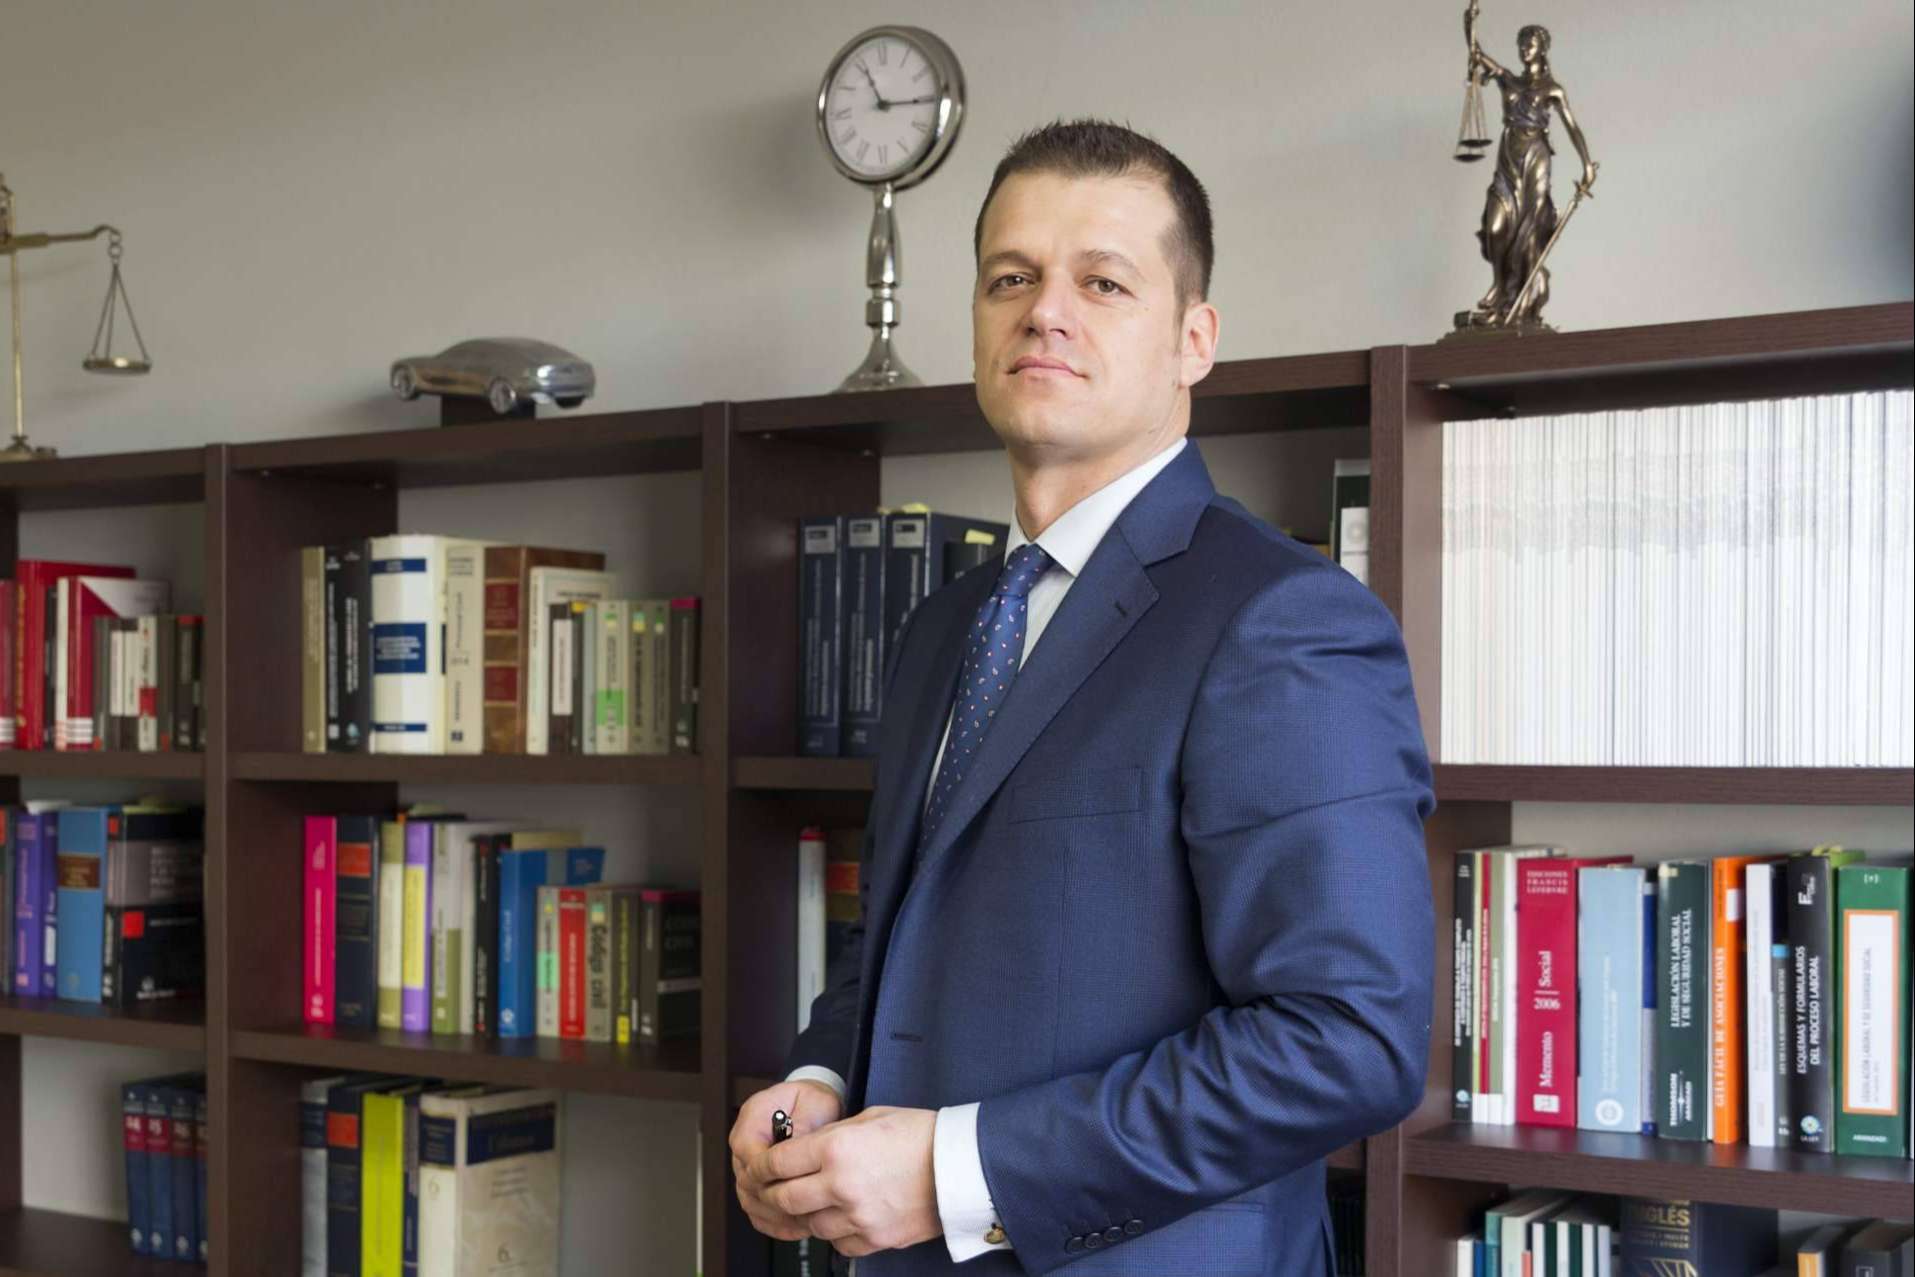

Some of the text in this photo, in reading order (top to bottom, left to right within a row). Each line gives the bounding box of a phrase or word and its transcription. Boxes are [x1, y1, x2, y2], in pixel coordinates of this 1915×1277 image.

[1526, 887, 1568, 895] LEFEBVRE
[589, 924, 608, 1009] Código civil
[1533, 998, 1561, 1010] 2006
[1668, 914, 1681, 1028] LEGISLACIÓN LABORAL
[1681, 908, 1692, 1028] Y DE SEGURIDAD SOCIAL
[1715, 947, 1726, 1025] ASOCIACIONES
[1538, 950, 1553, 1088] Memento Social
[1715, 1030, 1725, 1043] DE
[1795, 946, 1807, 1074] ESQUEMAS Y FORMULARIOS
[1809, 955, 1821, 1066] DEL PROCESO LABORAL
[1669, 1073, 1678, 1127] THOMSON
